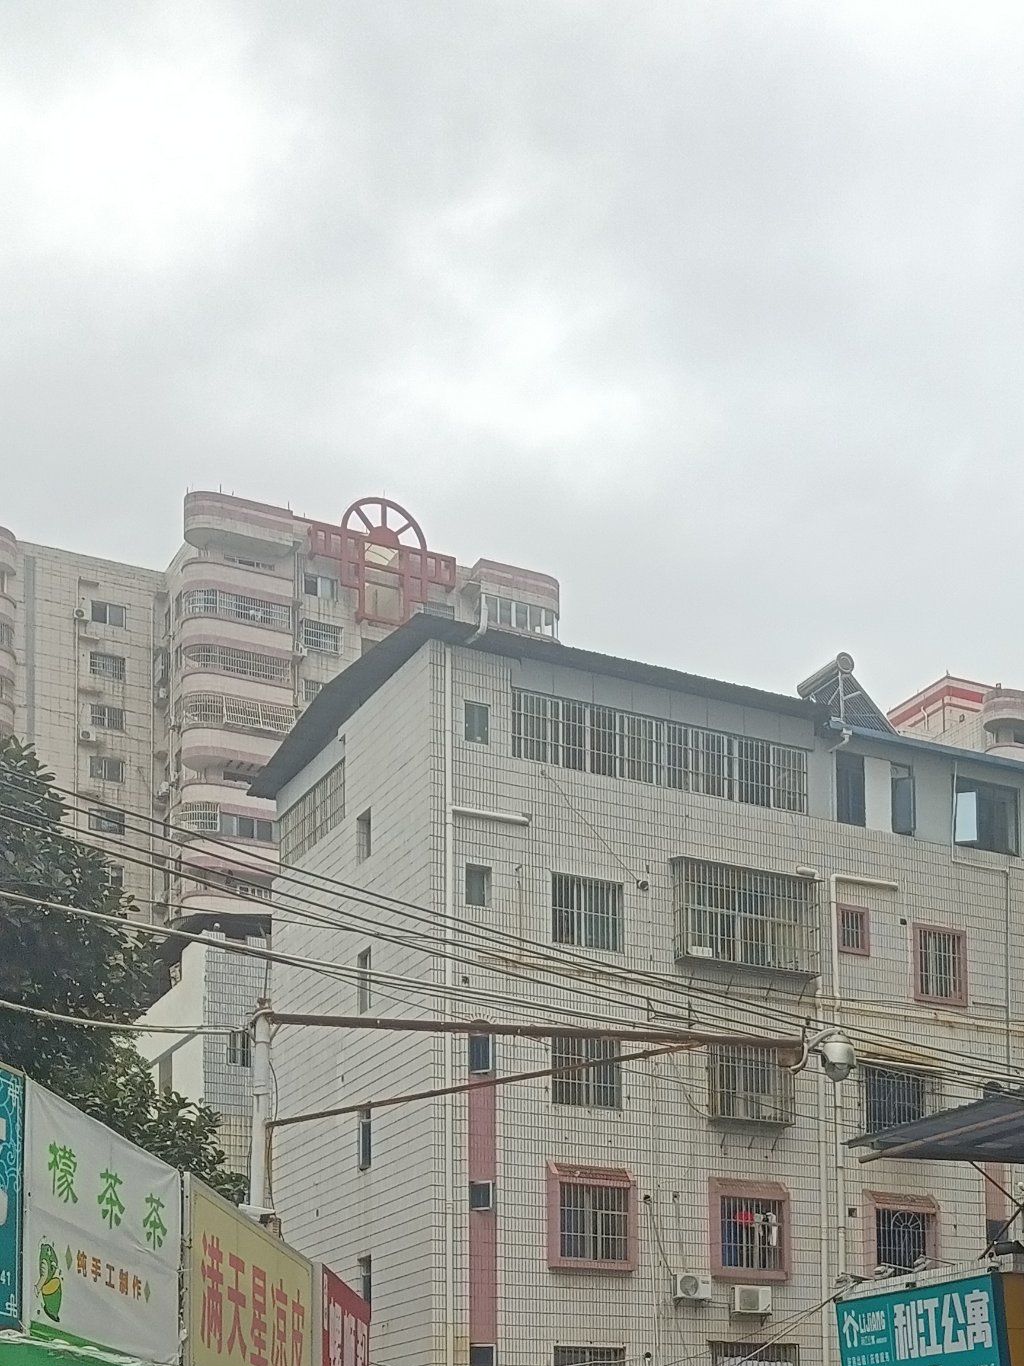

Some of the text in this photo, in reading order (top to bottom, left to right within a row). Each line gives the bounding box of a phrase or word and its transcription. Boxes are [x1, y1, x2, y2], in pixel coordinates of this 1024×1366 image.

[48, 1142, 168, 1251] 檬茶茶
[76, 1249, 142, 1300] 纯手工制作
[893, 1289, 993, 1361] 利江公寓
